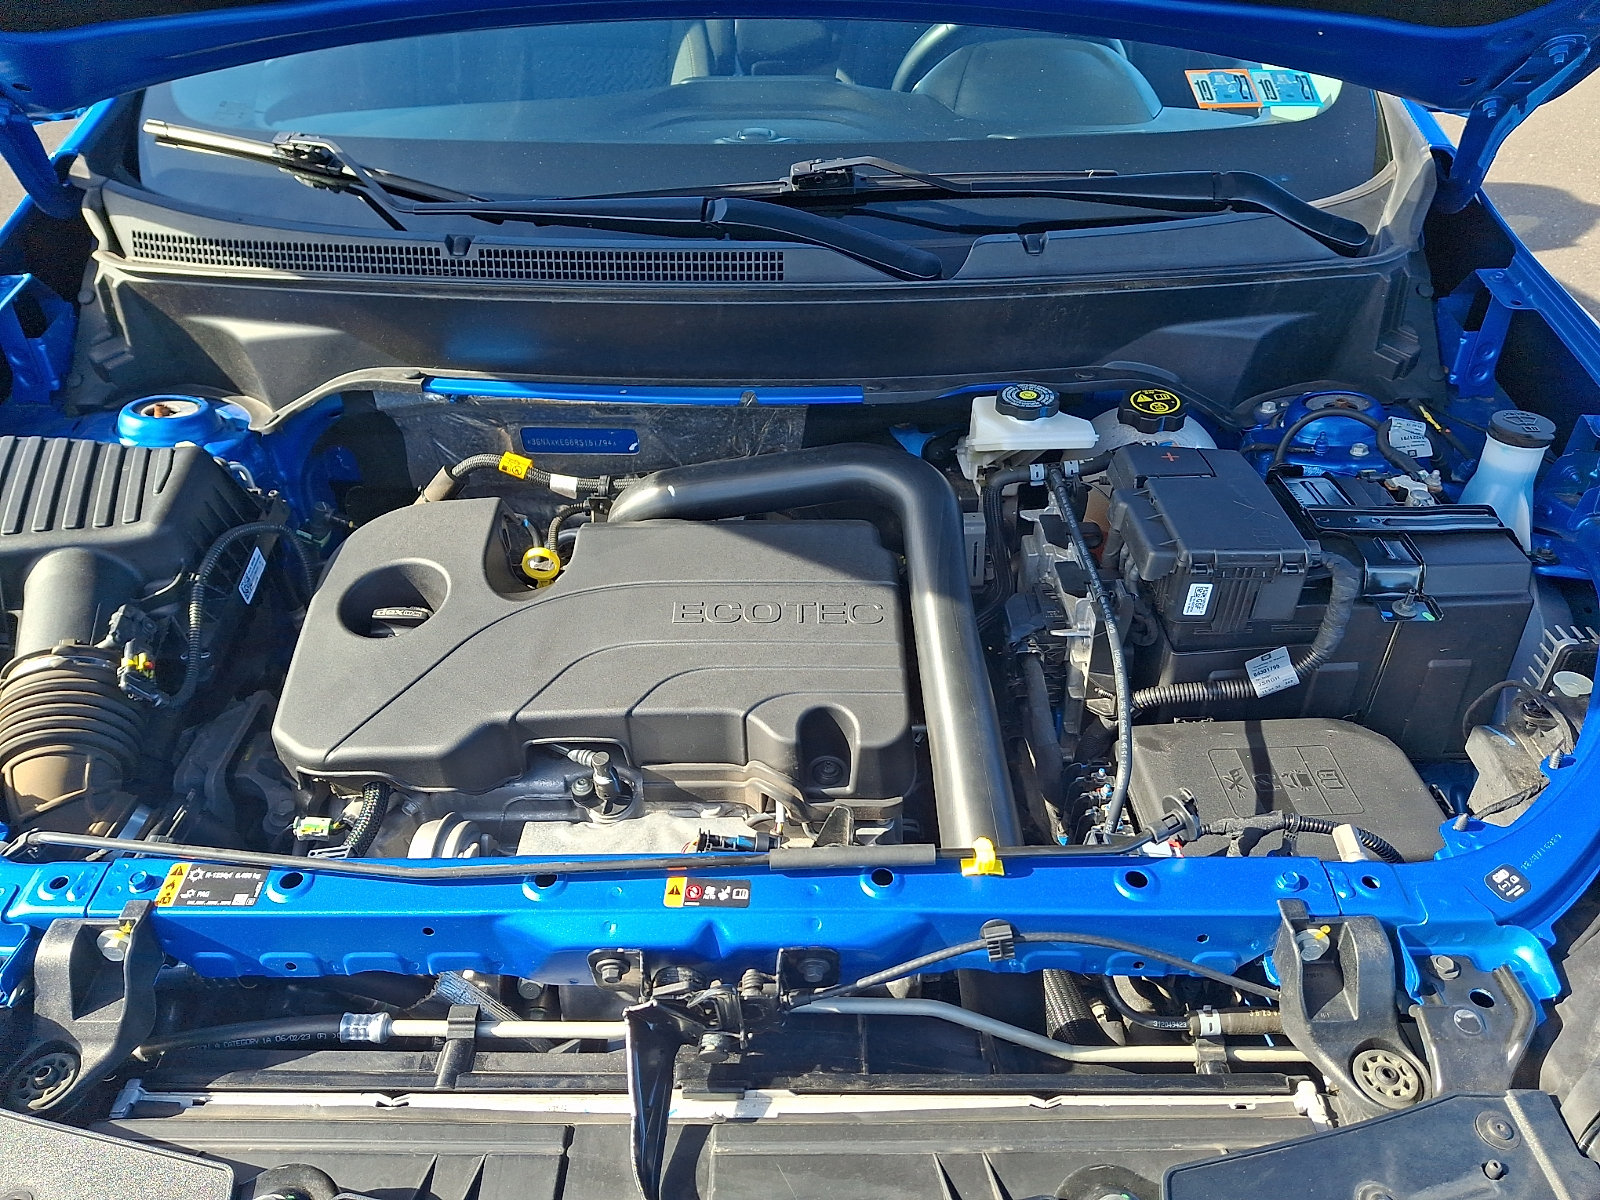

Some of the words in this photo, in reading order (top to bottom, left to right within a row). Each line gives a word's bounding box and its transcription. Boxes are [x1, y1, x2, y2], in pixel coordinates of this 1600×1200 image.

[1233, 75, 1254, 101] 27
[1294, 75, 1315, 101] 27
[375, 608, 423, 617] dexos
[671, 600, 885, 625] ECOTEC
[223, 1038, 260, 1048] CATEGORY
